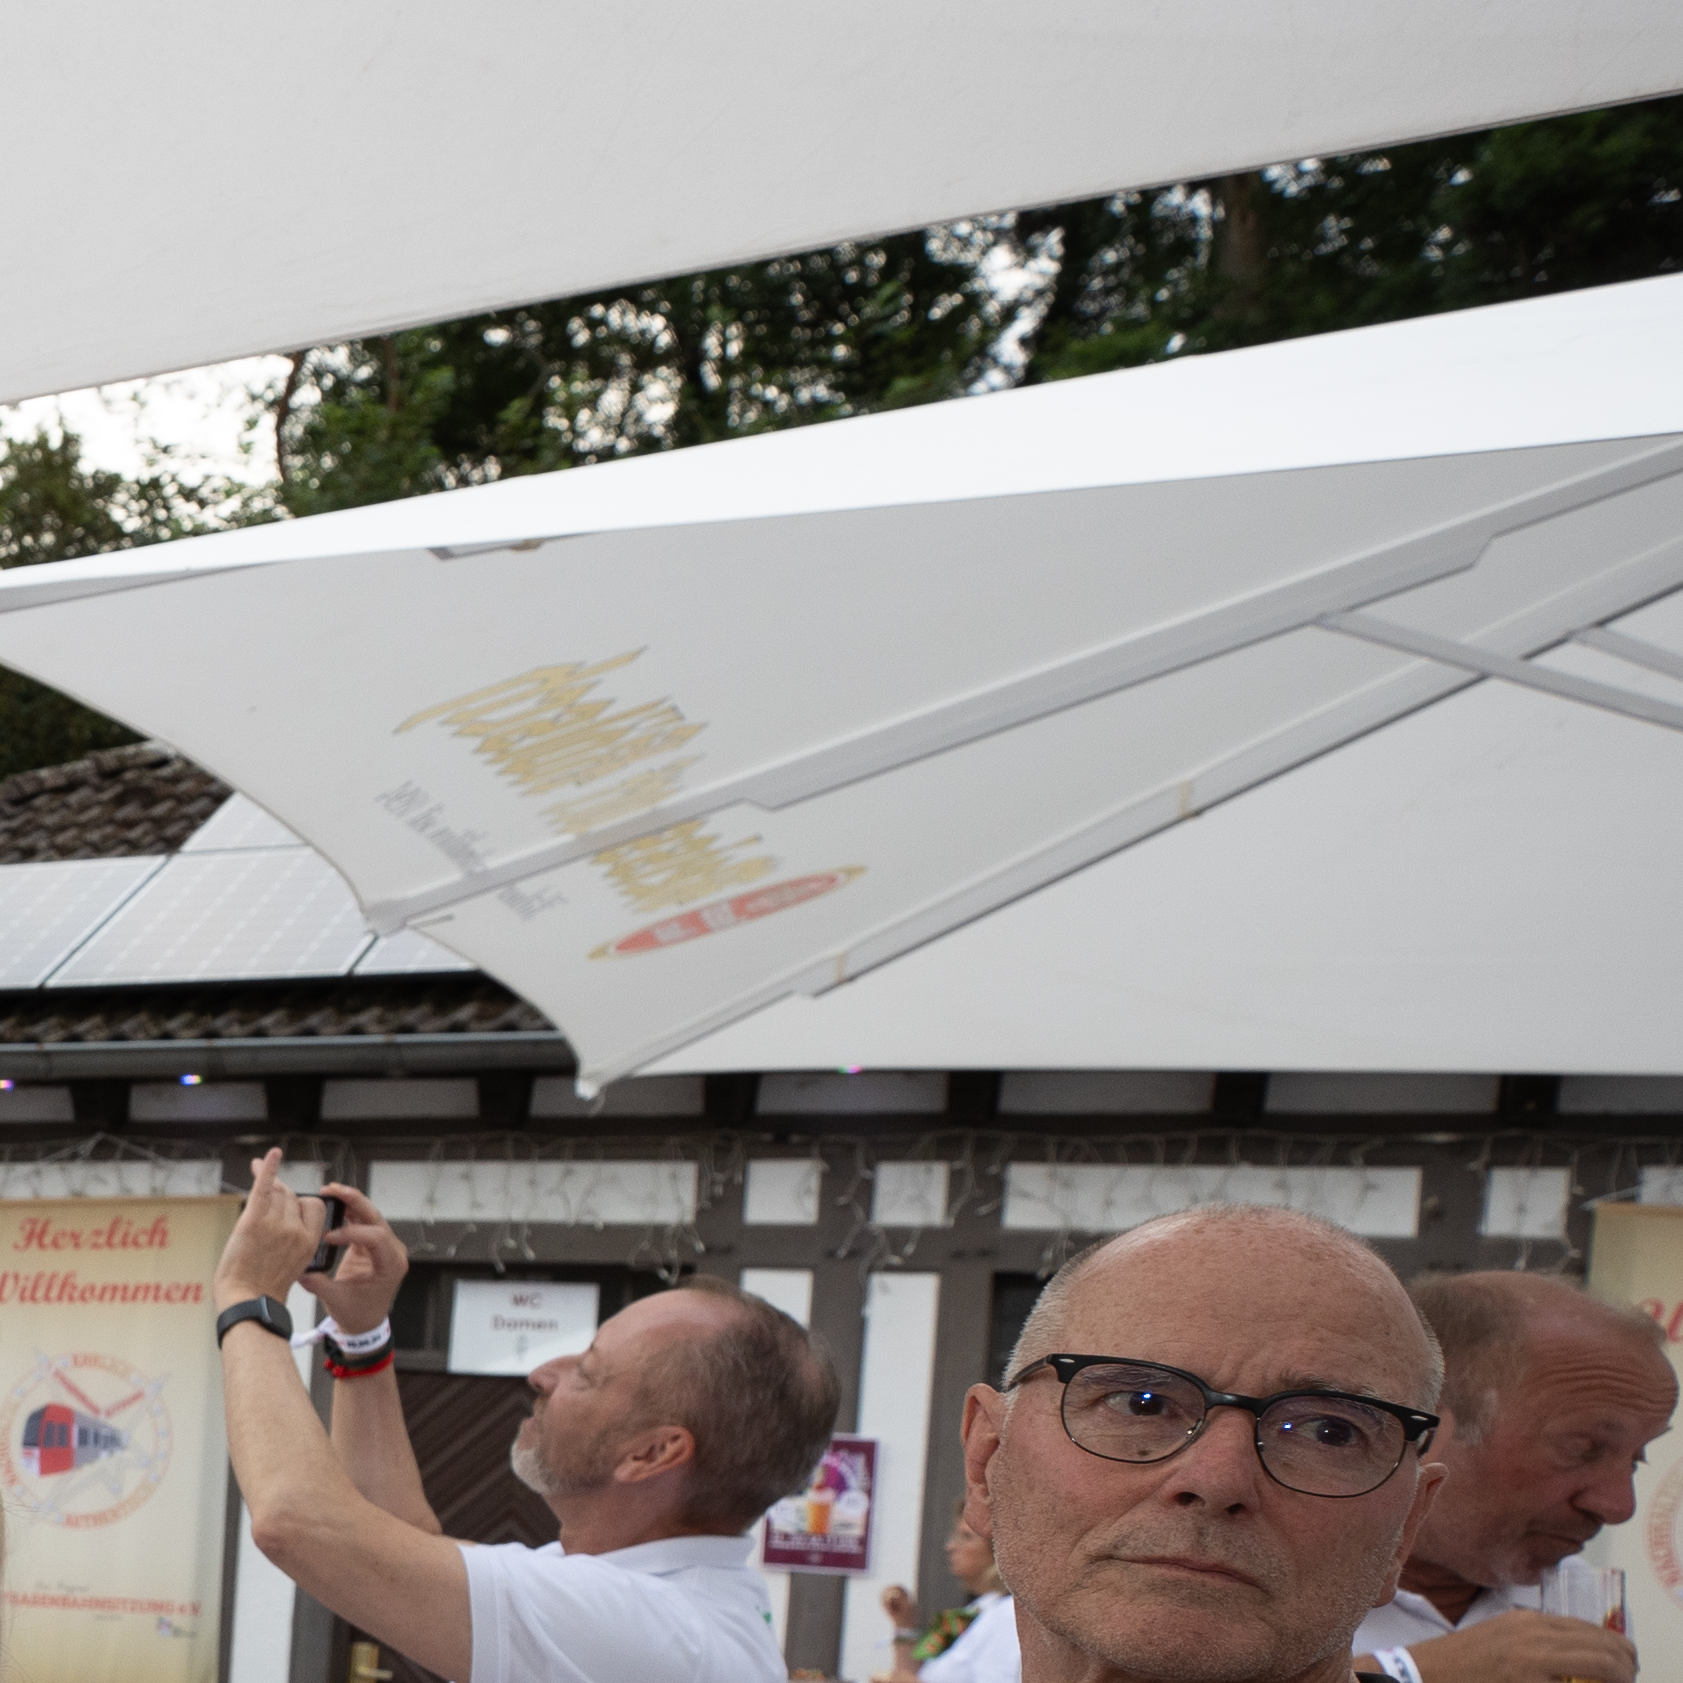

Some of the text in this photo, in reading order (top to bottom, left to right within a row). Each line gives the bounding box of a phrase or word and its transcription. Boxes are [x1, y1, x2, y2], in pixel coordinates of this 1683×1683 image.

[12, 1214, 170, 1252] Herzlich
[512, 1292, 542, 1309] WC
[492, 1314, 558, 1331] Damen
